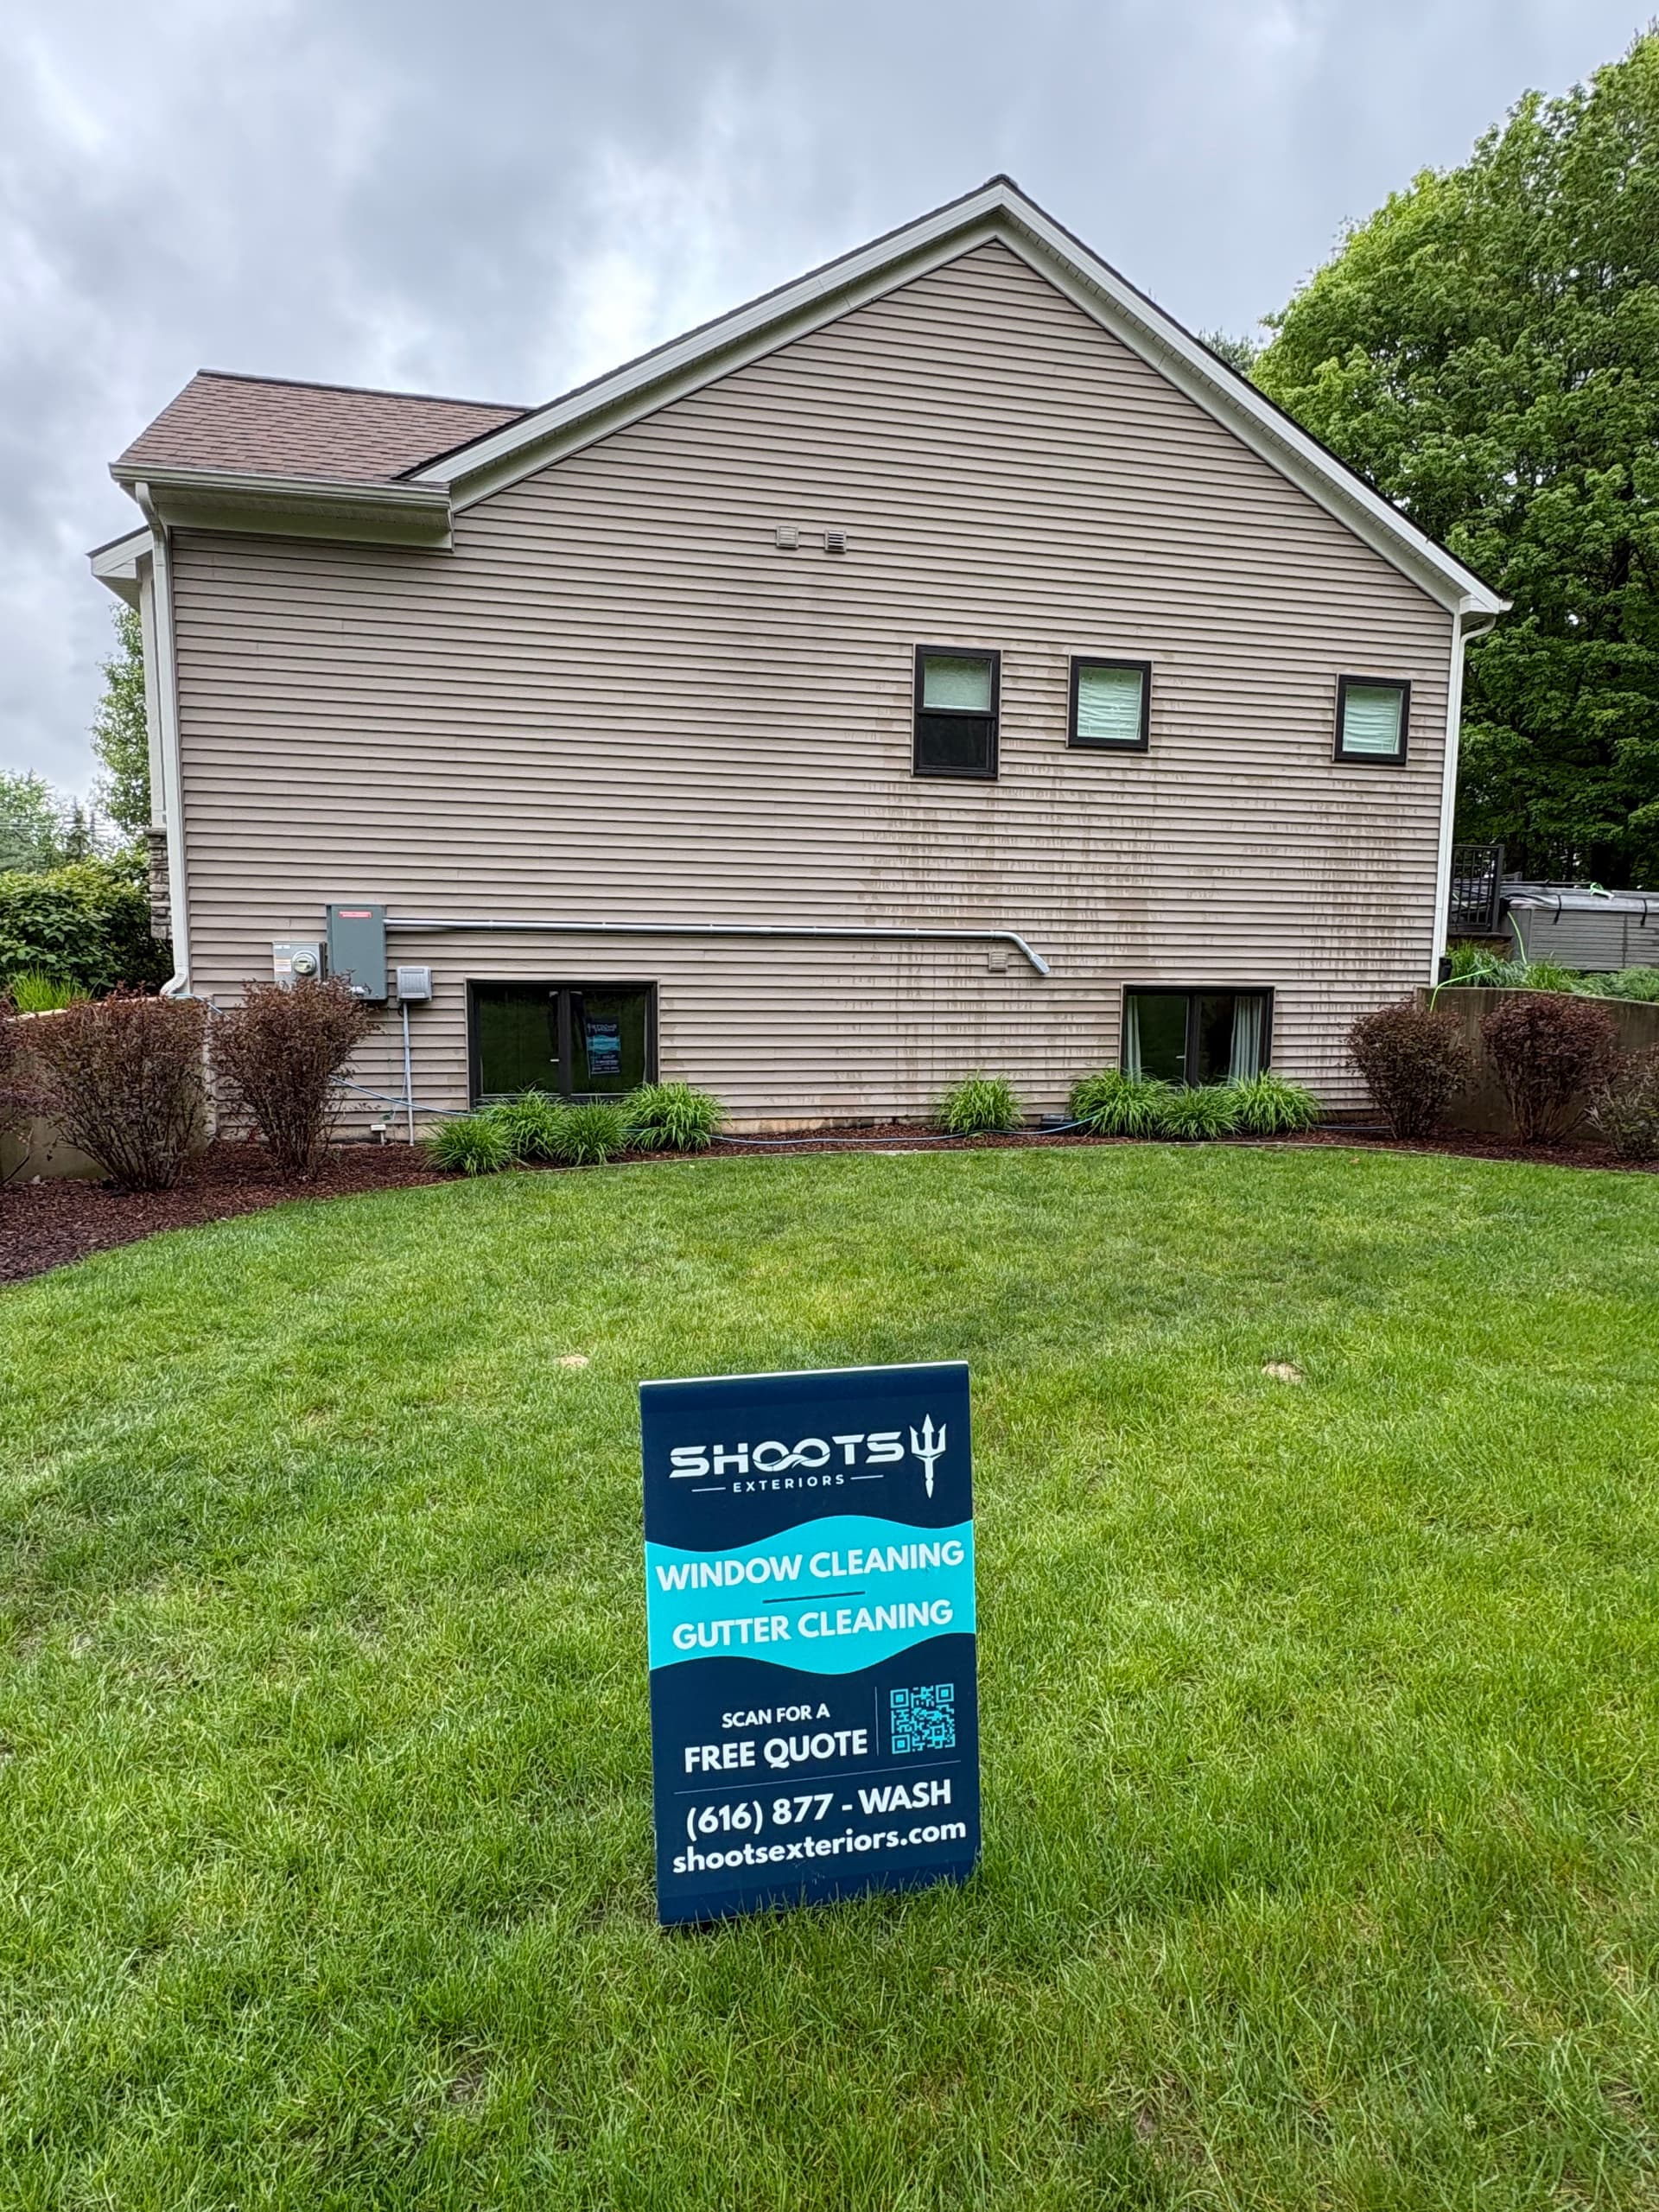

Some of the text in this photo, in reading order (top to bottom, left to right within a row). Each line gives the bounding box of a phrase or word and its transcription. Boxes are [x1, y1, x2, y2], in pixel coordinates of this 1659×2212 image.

[669, 1431, 905, 1478] SHOOTS
[733, 1474, 845, 1493] EXTERIORS
[655, 1540, 964, 1592] WINDOW CLEANING
[671, 1599, 953, 1650] GUTTER CLEANING
[721, 1703, 830, 1728] SCAN FOR A
[683, 1729, 868, 1773] FREE QUOTE
[686, 1800, 763, 1841] (616)
[772, 1793, 834, 1825] 877
[858, 1779, 951, 1815] WASH
[672, 1821, 966, 1873] shootsexteriors.com
